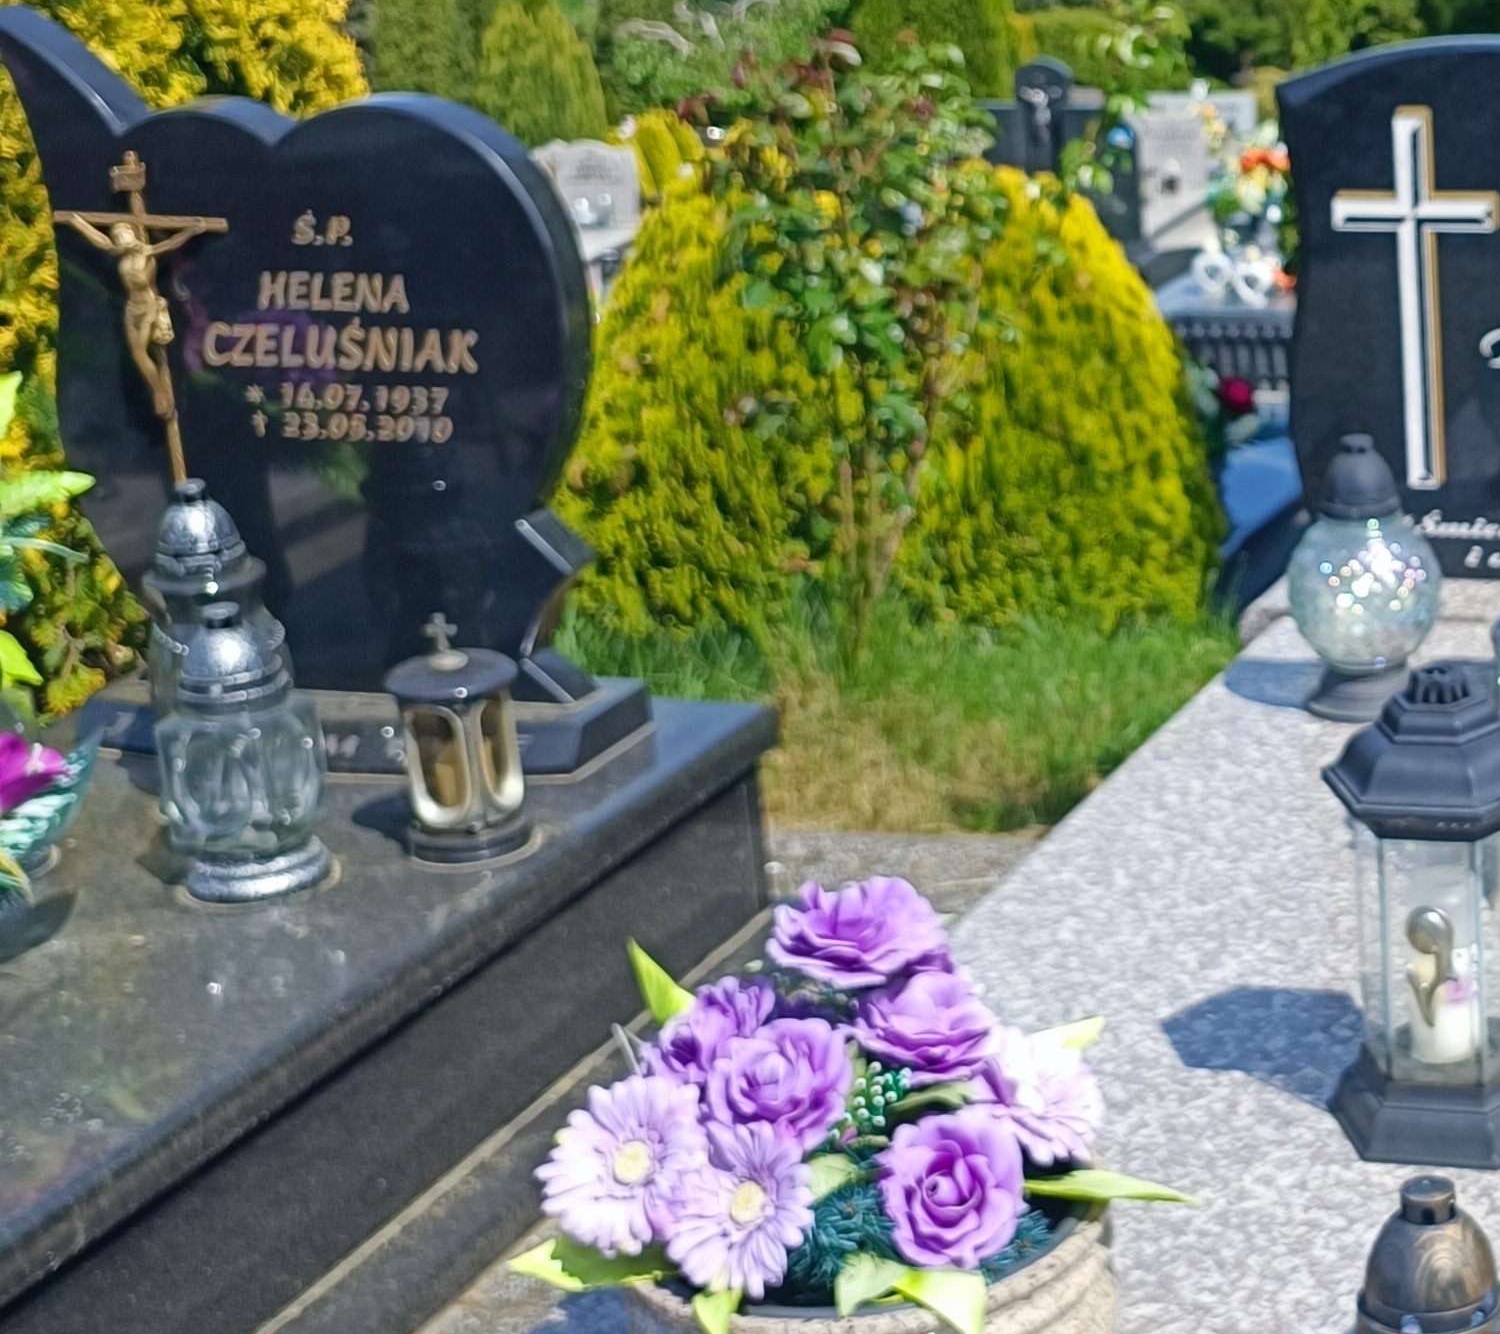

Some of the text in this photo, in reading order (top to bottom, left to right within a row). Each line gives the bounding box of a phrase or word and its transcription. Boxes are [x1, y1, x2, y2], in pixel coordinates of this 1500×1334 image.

[291, 209, 353, 247] Ś.P.
[256, 270, 410, 315] HELENA
[202, 315, 480, 375] CZELUŚNIAK
